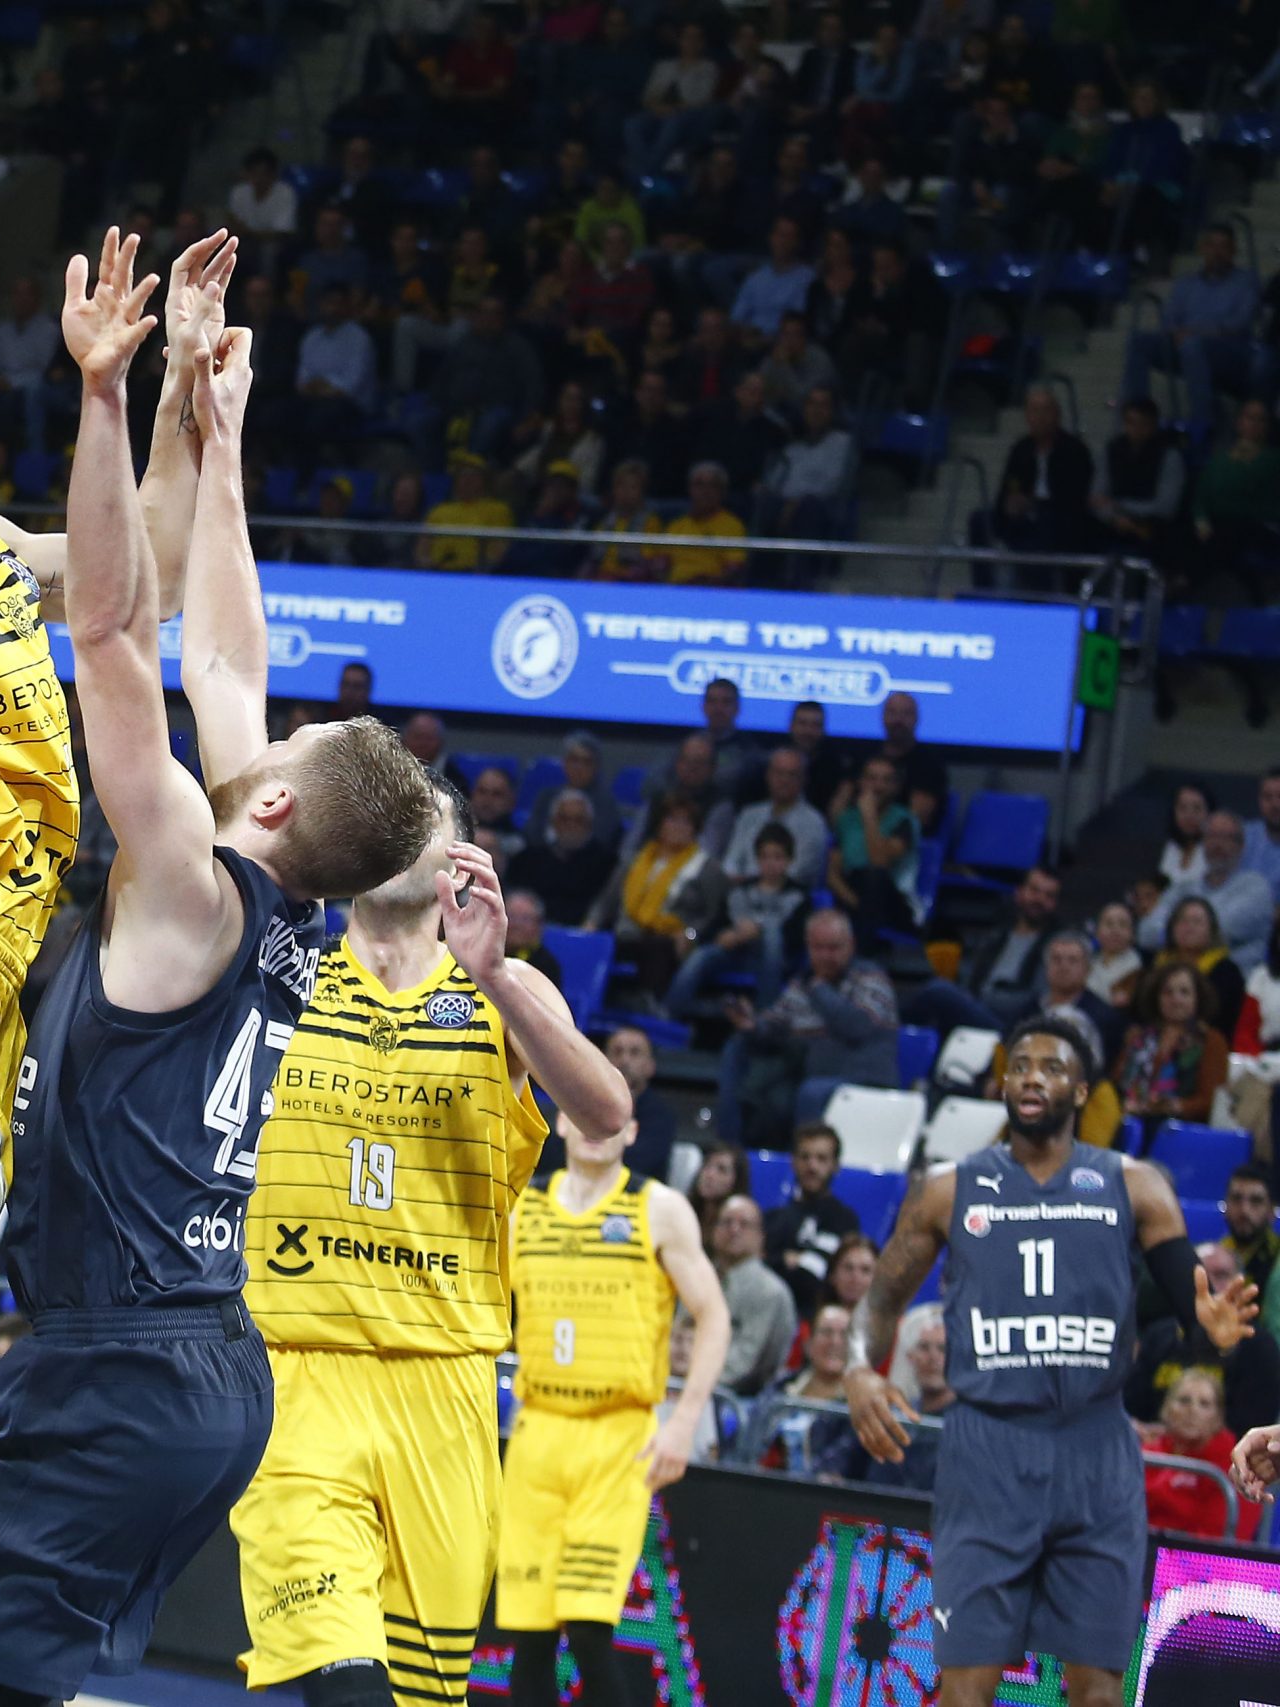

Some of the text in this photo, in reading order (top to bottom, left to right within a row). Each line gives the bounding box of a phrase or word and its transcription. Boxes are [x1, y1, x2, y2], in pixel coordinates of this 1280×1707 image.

[263, 593, 407, 625] TRAINING
[584, 612, 996, 660] TENERIFE TOP TRAINING
[276, 1068, 454, 1107] IBEROSTAR
[281, 1099, 442, 1129] HOTELS & RESORTS
[346, 1137, 395, 1211] 19
[317, 1235, 459, 1276] TENERIFE
[1018, 1237, 1055, 1297] 11
[554, 1318, 575, 1366] 9
[970, 1306, 1116, 1356] brose
